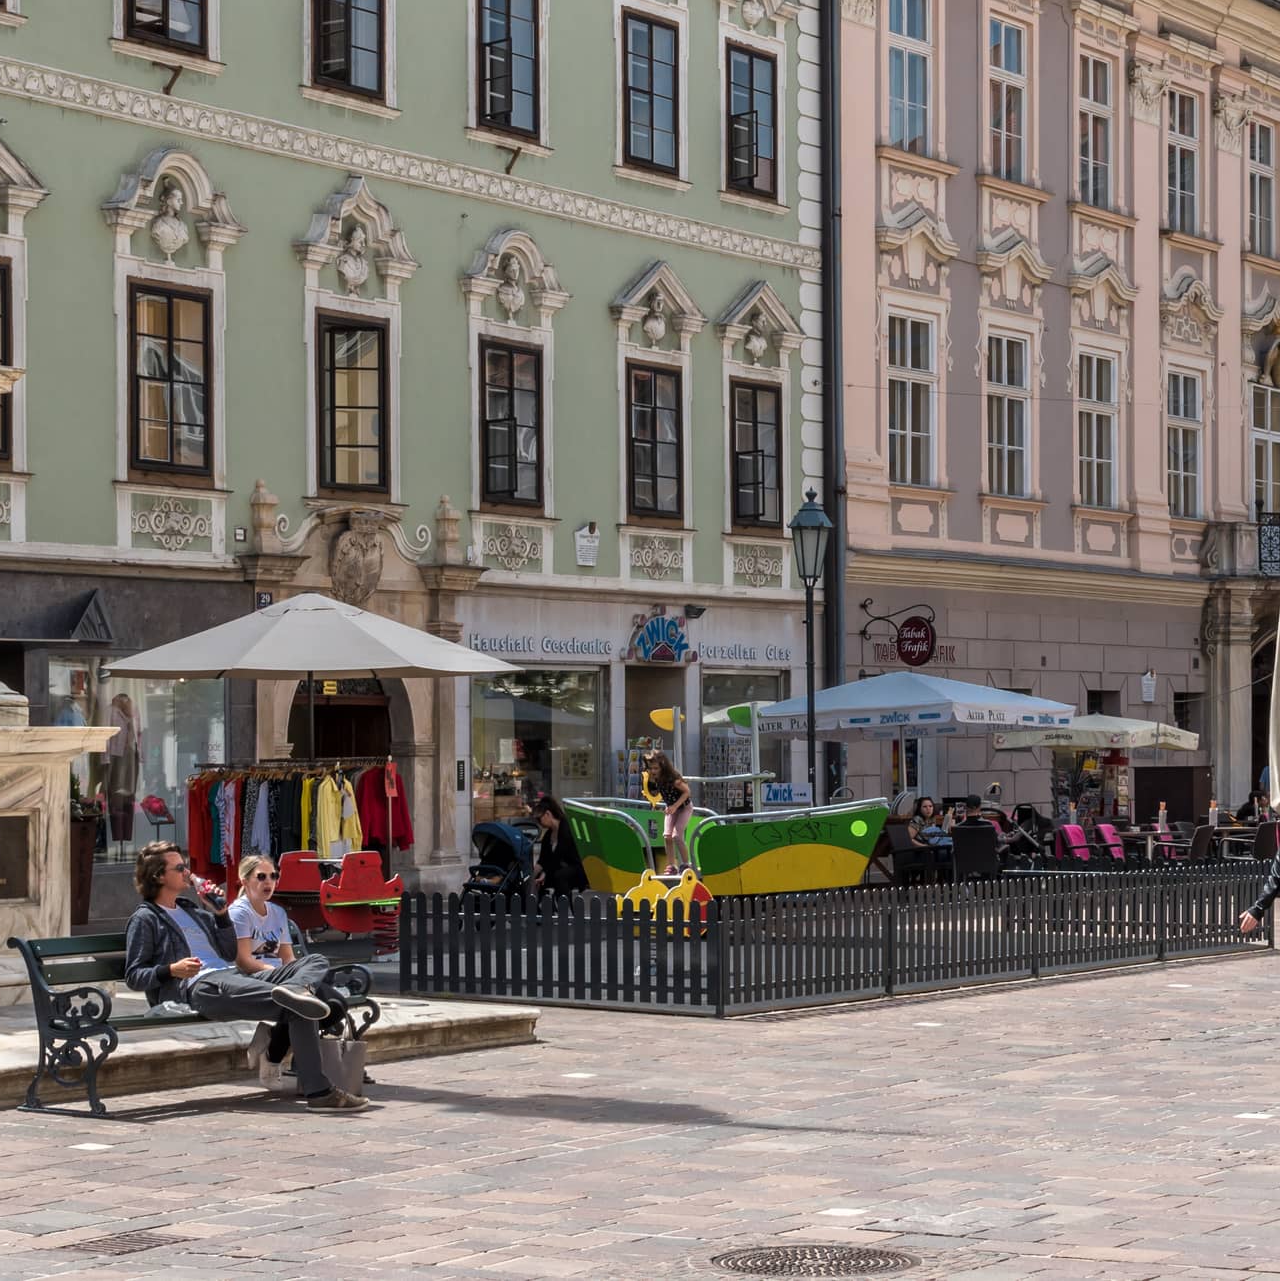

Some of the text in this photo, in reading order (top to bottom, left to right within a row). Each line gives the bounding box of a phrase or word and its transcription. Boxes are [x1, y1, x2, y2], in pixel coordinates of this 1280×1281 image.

[635, 617, 689, 662] ZWICK
[900, 626, 927, 638] Tabak
[470, 633, 792, 661] Haushalt Geschenke Porzellan Glas
[901, 640, 929, 659] Trafik
[880, 711, 911, 724] ZWICK
[967, 710, 985, 720] ALTER
[766, 784, 793, 802] Zwick
